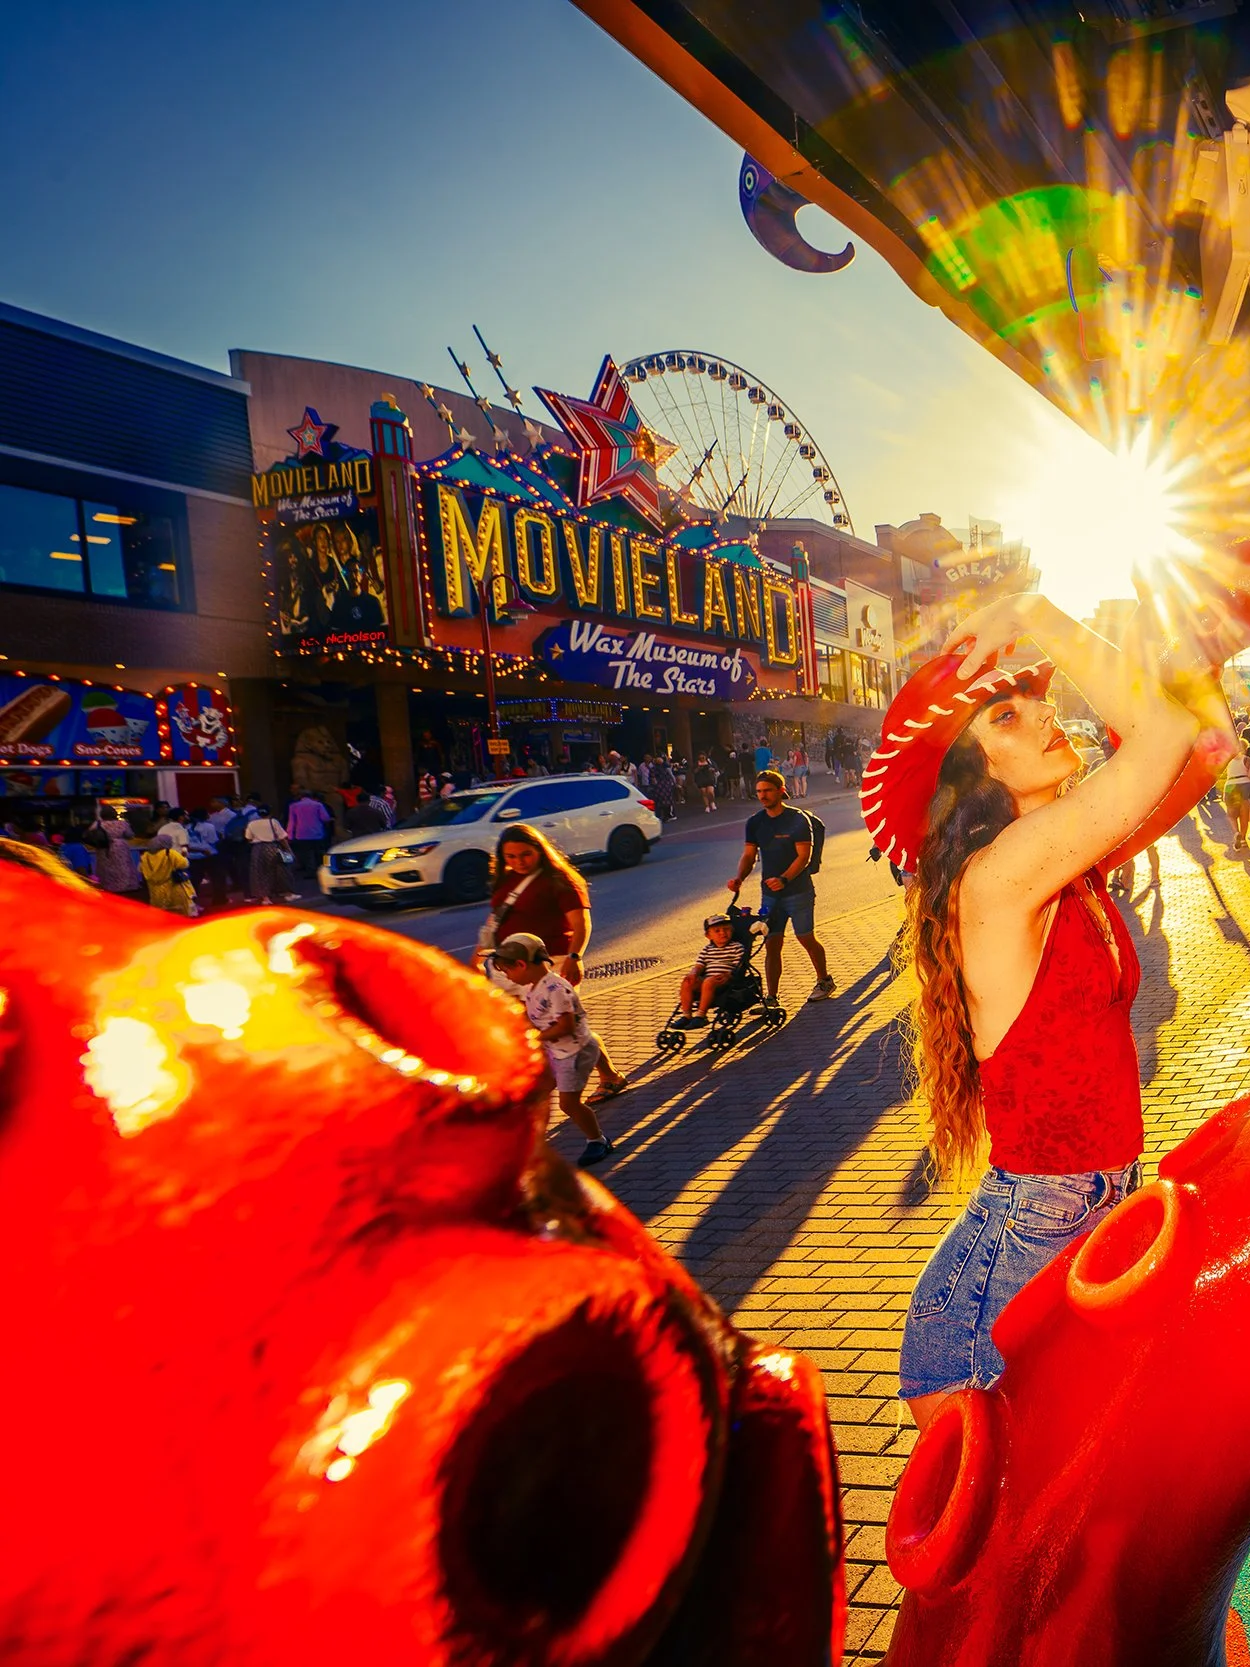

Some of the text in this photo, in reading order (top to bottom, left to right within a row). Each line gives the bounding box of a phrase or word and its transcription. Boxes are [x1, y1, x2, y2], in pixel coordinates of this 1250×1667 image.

[251, 459, 371, 507] MOVIELAND
[299, 496, 340, 508] Museum
[341, 489, 353, 507] of
[312, 507, 340, 520] Stars
[436, 483, 798, 665] MOVIELAND
[945, 562, 1004, 583] GREAT
[326, 631, 386, 644] Nicholson
[570, 620, 742, 683] Wax Museum of
[608, 660, 716, 696] The Stars
[0, 743, 52, 757] ot Dogs
[75, 743, 141, 756] Sno-Cones
